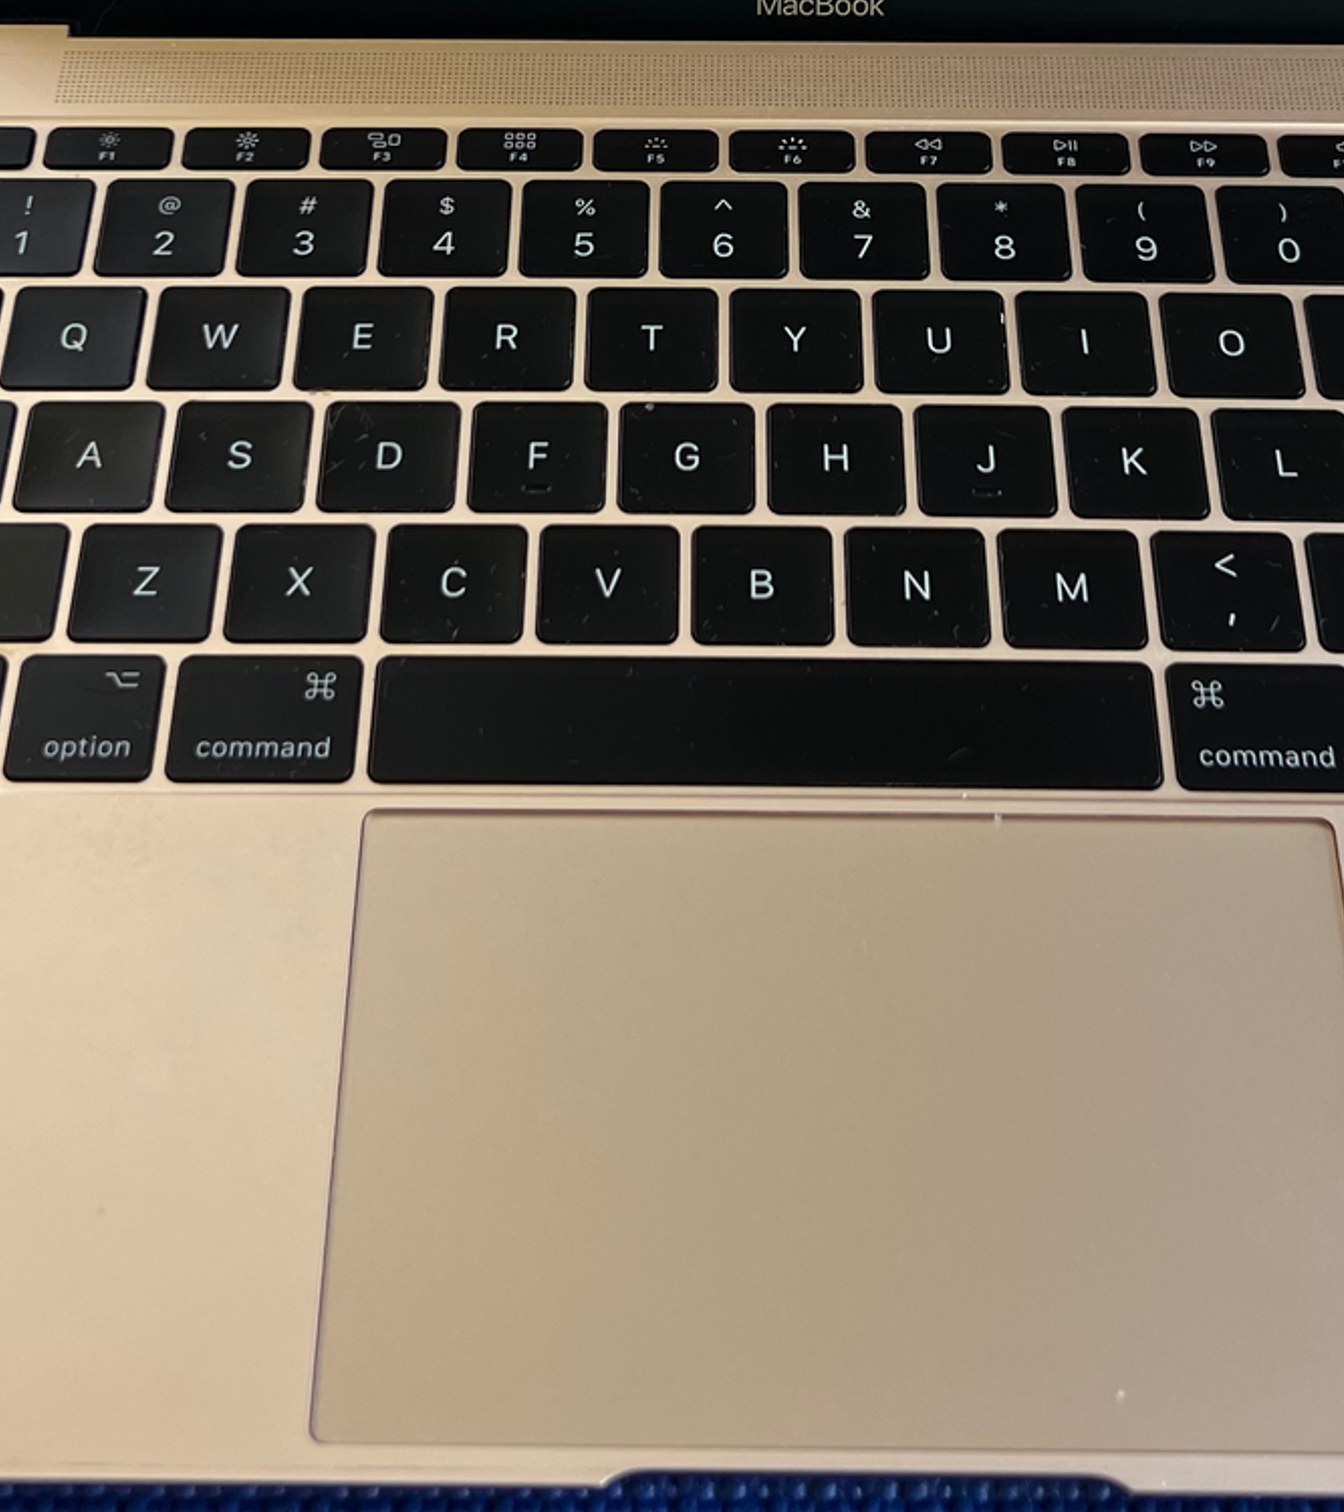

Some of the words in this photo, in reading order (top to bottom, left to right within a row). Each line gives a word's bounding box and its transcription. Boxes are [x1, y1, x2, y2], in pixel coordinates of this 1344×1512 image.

[236, 151, 255, 163] F2
[509, 151, 528, 162] F4
[783, 154, 803, 165] F6
[1057, 156, 1076, 167] F8
[152, 230, 175, 256] 2
[292, 230, 315, 256] 3
[573, 231, 595, 257] 5
[853, 234, 874, 259] 7
[60, 322, 88, 352] Q
[202, 323, 239, 350] W
[495, 323, 519, 350] R
[783, 326, 807, 353] Y
[75, 440, 102, 469] A
[227, 440, 253, 470] S
[674, 441, 700, 472] G
[823, 443, 849, 472] H
[1121, 447, 1148, 476] K
[132, 566, 161, 596] Z
[285, 566, 314, 597] X
[440, 566, 467, 598] C
[750, 568, 775, 600] B
[1055, 572, 1089, 603] M
[43, 734, 131, 762] option
[195, 736, 331, 759] command
[1199, 745, 1336, 769] command
